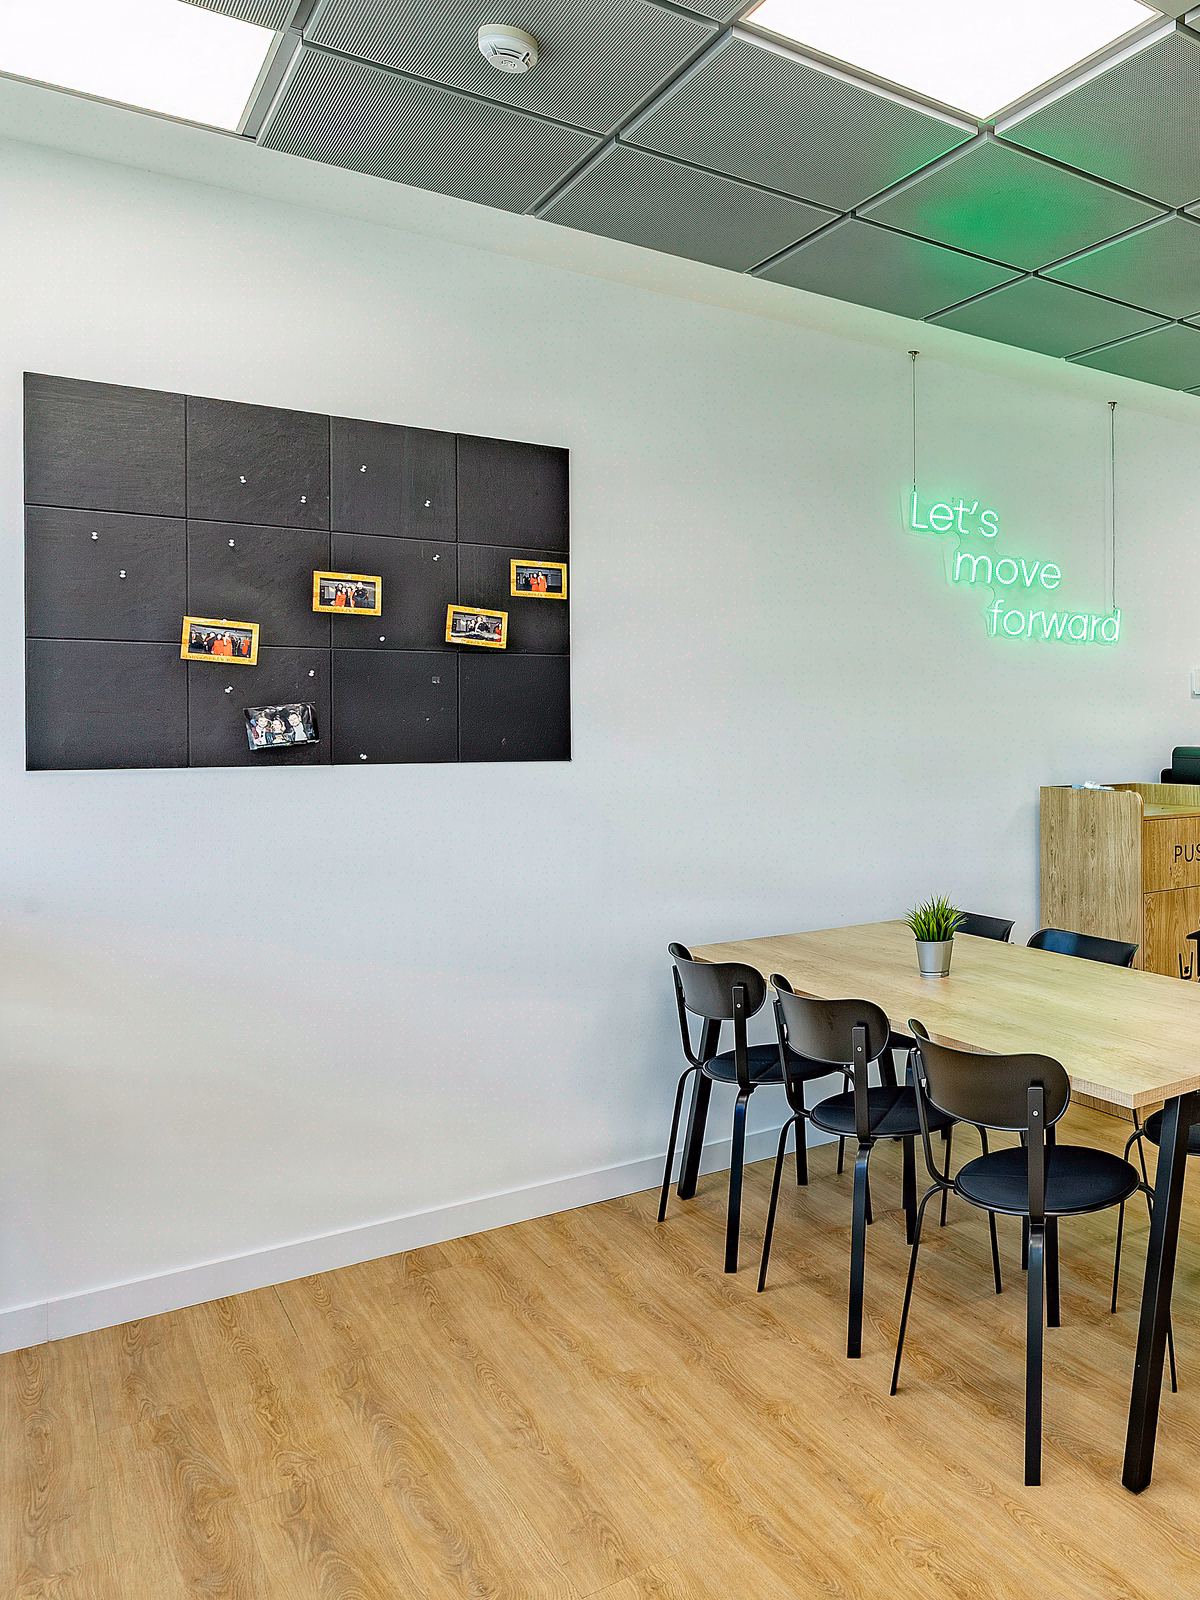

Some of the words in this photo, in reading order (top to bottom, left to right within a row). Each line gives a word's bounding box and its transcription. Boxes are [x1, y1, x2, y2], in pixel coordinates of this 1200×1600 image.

[910, 491, 999, 537] Let's
[953, 552, 1062, 589] move
[988, 599, 1121, 642] forward
